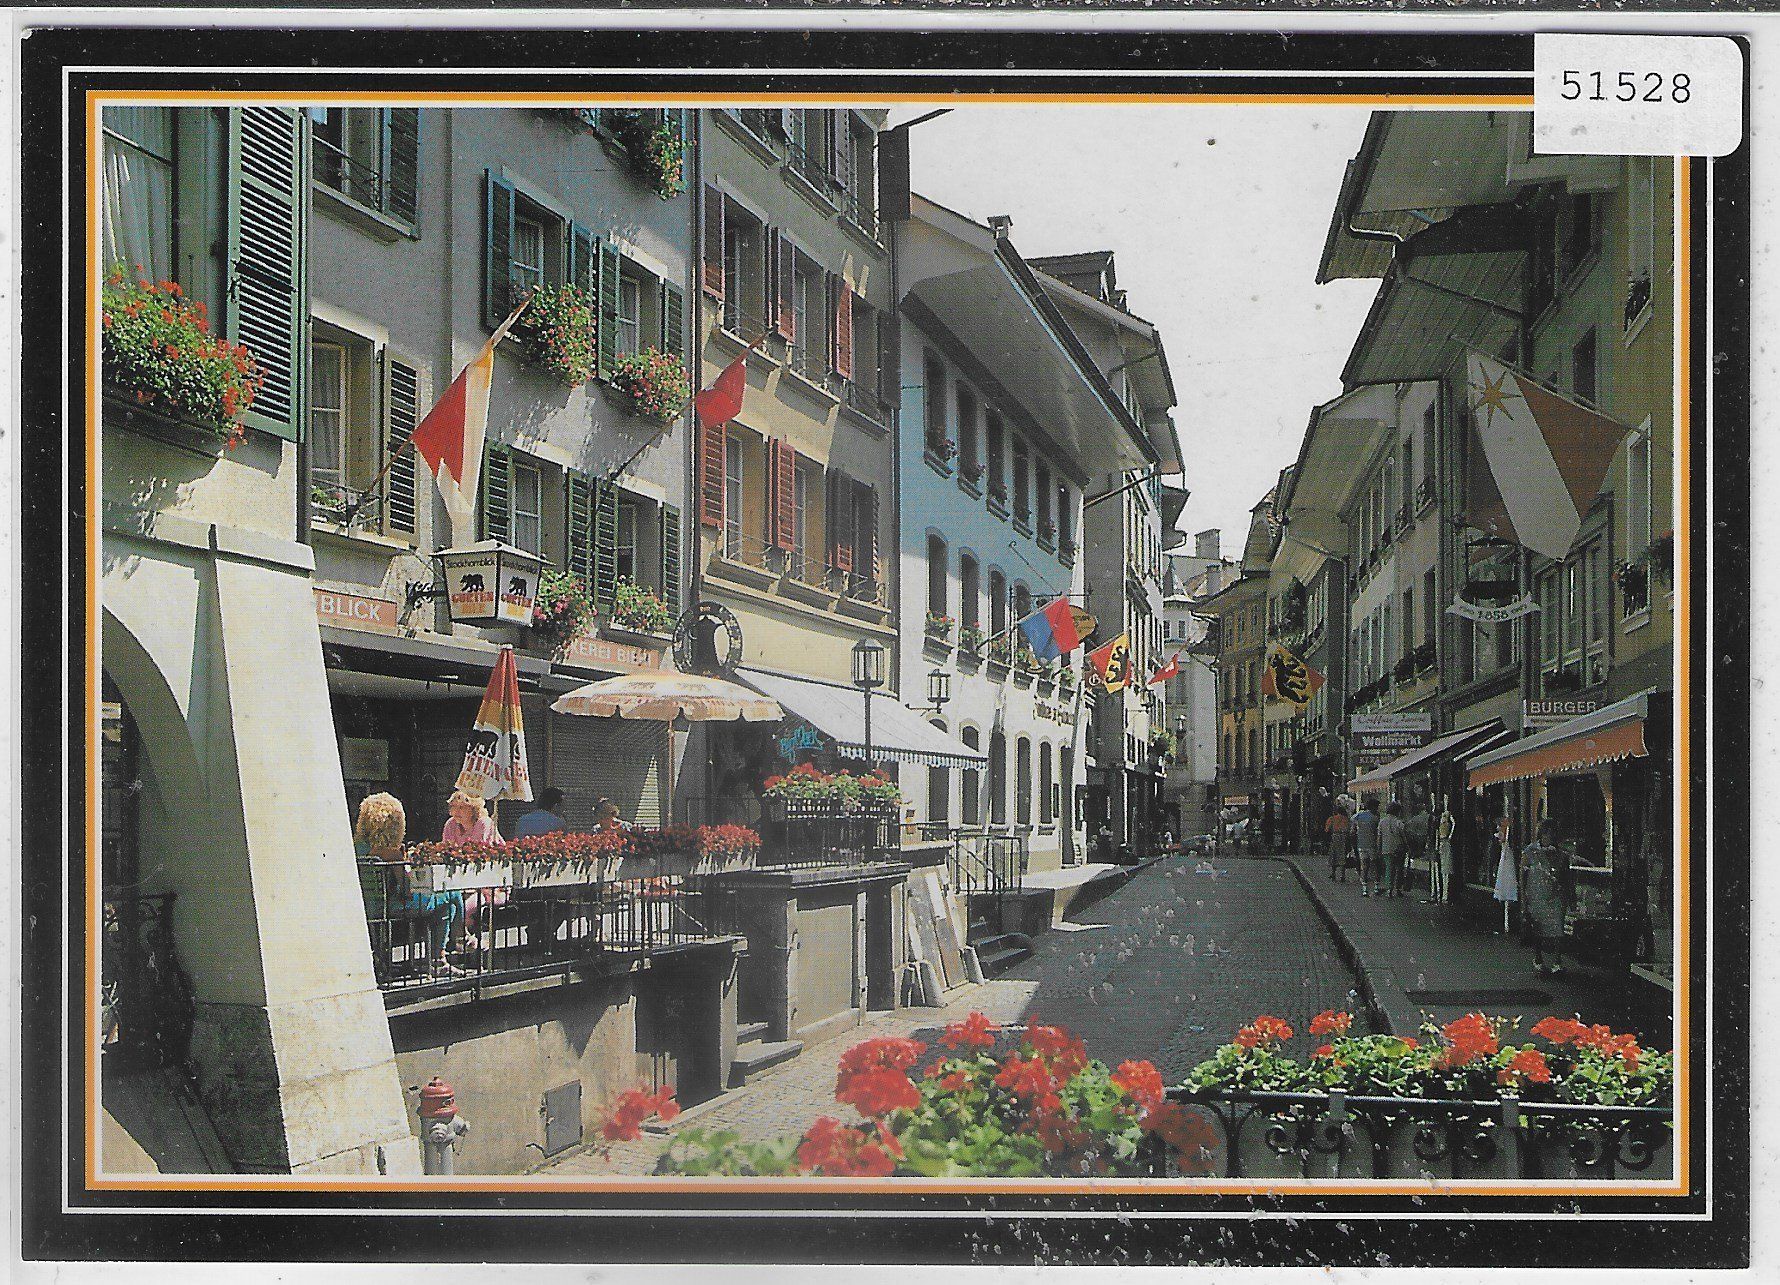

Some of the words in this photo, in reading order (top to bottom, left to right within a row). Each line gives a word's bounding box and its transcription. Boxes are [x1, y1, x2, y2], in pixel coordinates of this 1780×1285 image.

[1561, 70, 1691, 103] 51528
[321, 594, 381, 621] BLICK
[1530, 701, 1597, 714] BURGER
